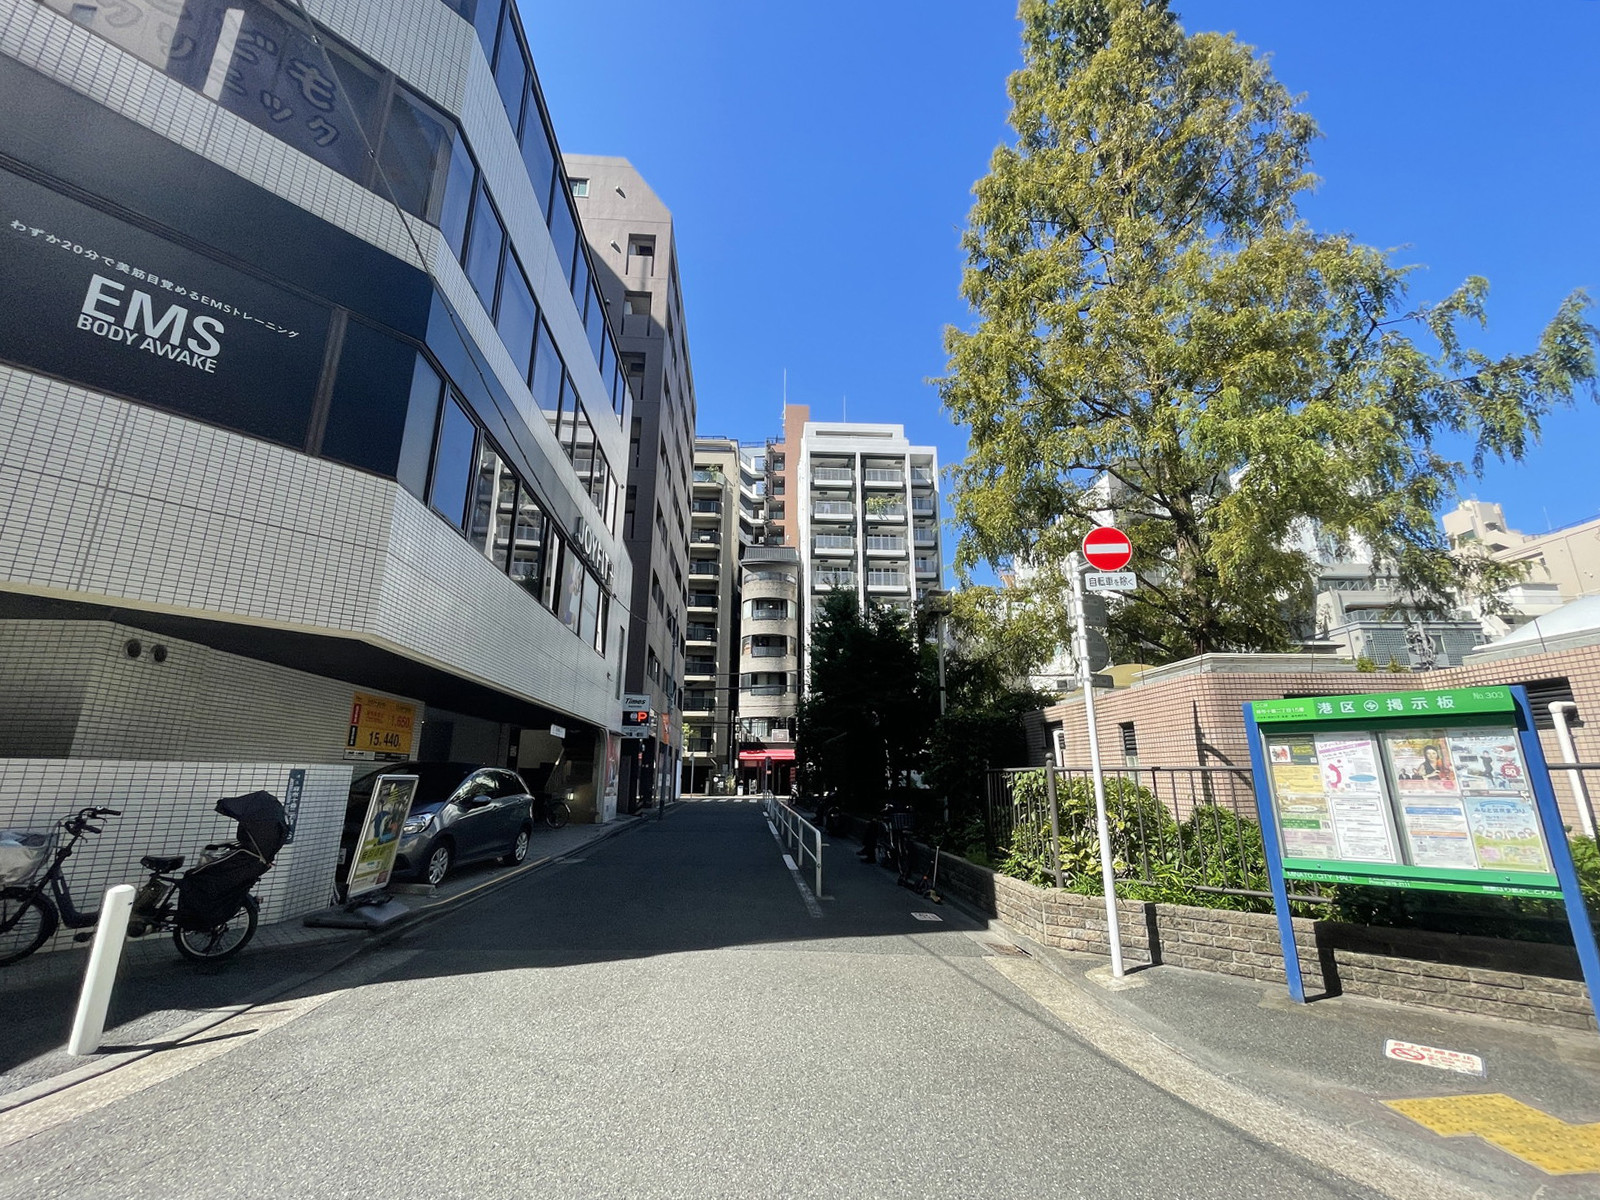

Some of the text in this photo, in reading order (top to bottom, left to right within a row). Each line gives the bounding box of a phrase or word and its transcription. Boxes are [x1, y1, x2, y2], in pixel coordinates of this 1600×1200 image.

[10, 219, 300, 338] わずか20分で美筋目覚めるEMSトレーニング
[81, 273, 225, 358] EMS
[76, 313, 218, 374] BODY AWAKE
[1089, 576, 1134, 587] 自転車を除く
[625, 697, 646, 705] Times
[1317, 695, 1455, 714] 港区 掲示板
[637, 711, 648, 722] P
[1286, 871, 1314, 879] MINATO
